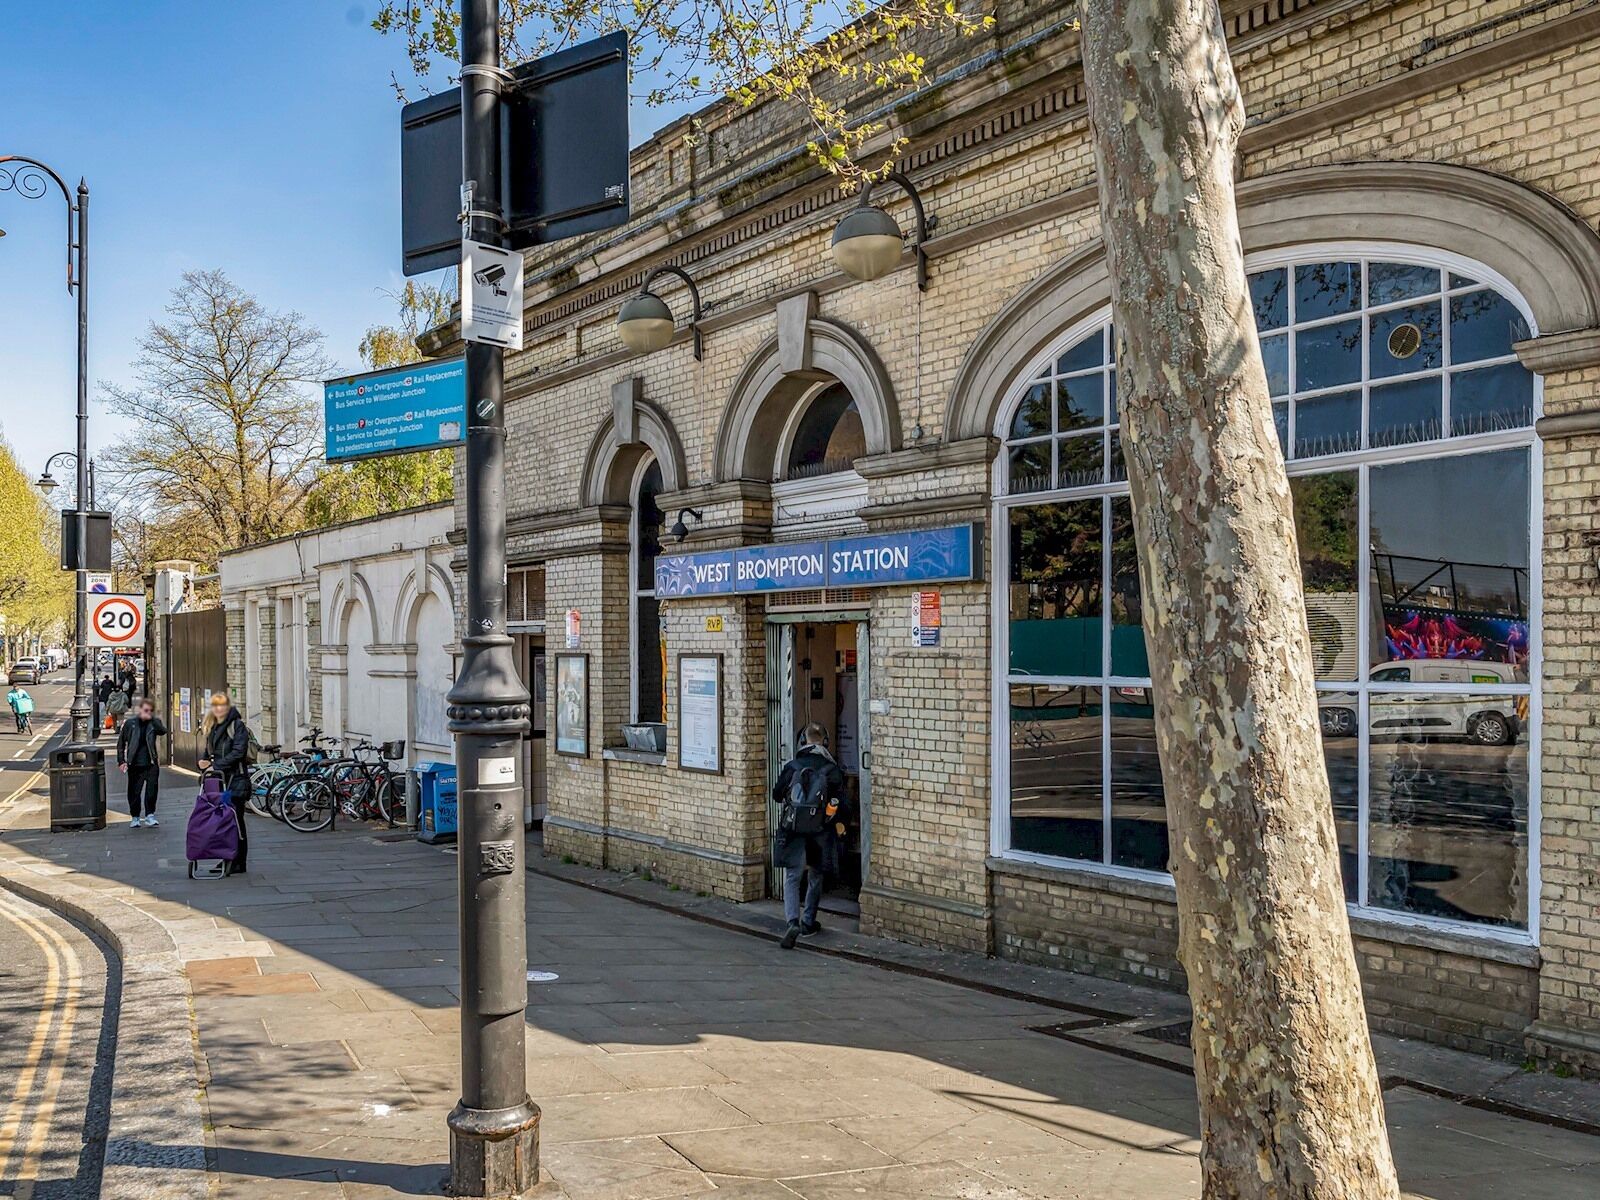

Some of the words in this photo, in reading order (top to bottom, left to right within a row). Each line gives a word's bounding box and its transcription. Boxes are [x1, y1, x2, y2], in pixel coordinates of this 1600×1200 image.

[335, 390, 345, 398] Bus
[346, 388, 358, 397] stop
[364, 384, 373, 393] for
[413, 376, 425, 384] Rail
[426, 369, 462, 382] Replacement
[346, 398, 365, 408] Service
[373, 392, 401, 403] Willesden
[401, 388, 426, 397] Junction
[336, 424, 346, 432] Bus
[346, 422, 358, 430] stop
[414, 410, 425, 419] Rail
[426, 404, 463, 418] Replacement
[346, 432, 366, 441] Service
[374, 426, 398, 437] Clapham
[399, 423, 423, 433] Junction
[345, 441, 373, 453] pedestrian
[374, 438, 397, 448] crossing
[694, 562, 730, 584] WEST
[737, 554, 823, 580] BROMPTON
[832, 545, 909, 573] STATION
[102, 611, 134, 629] 20
[707, 619, 721, 629] RVP
